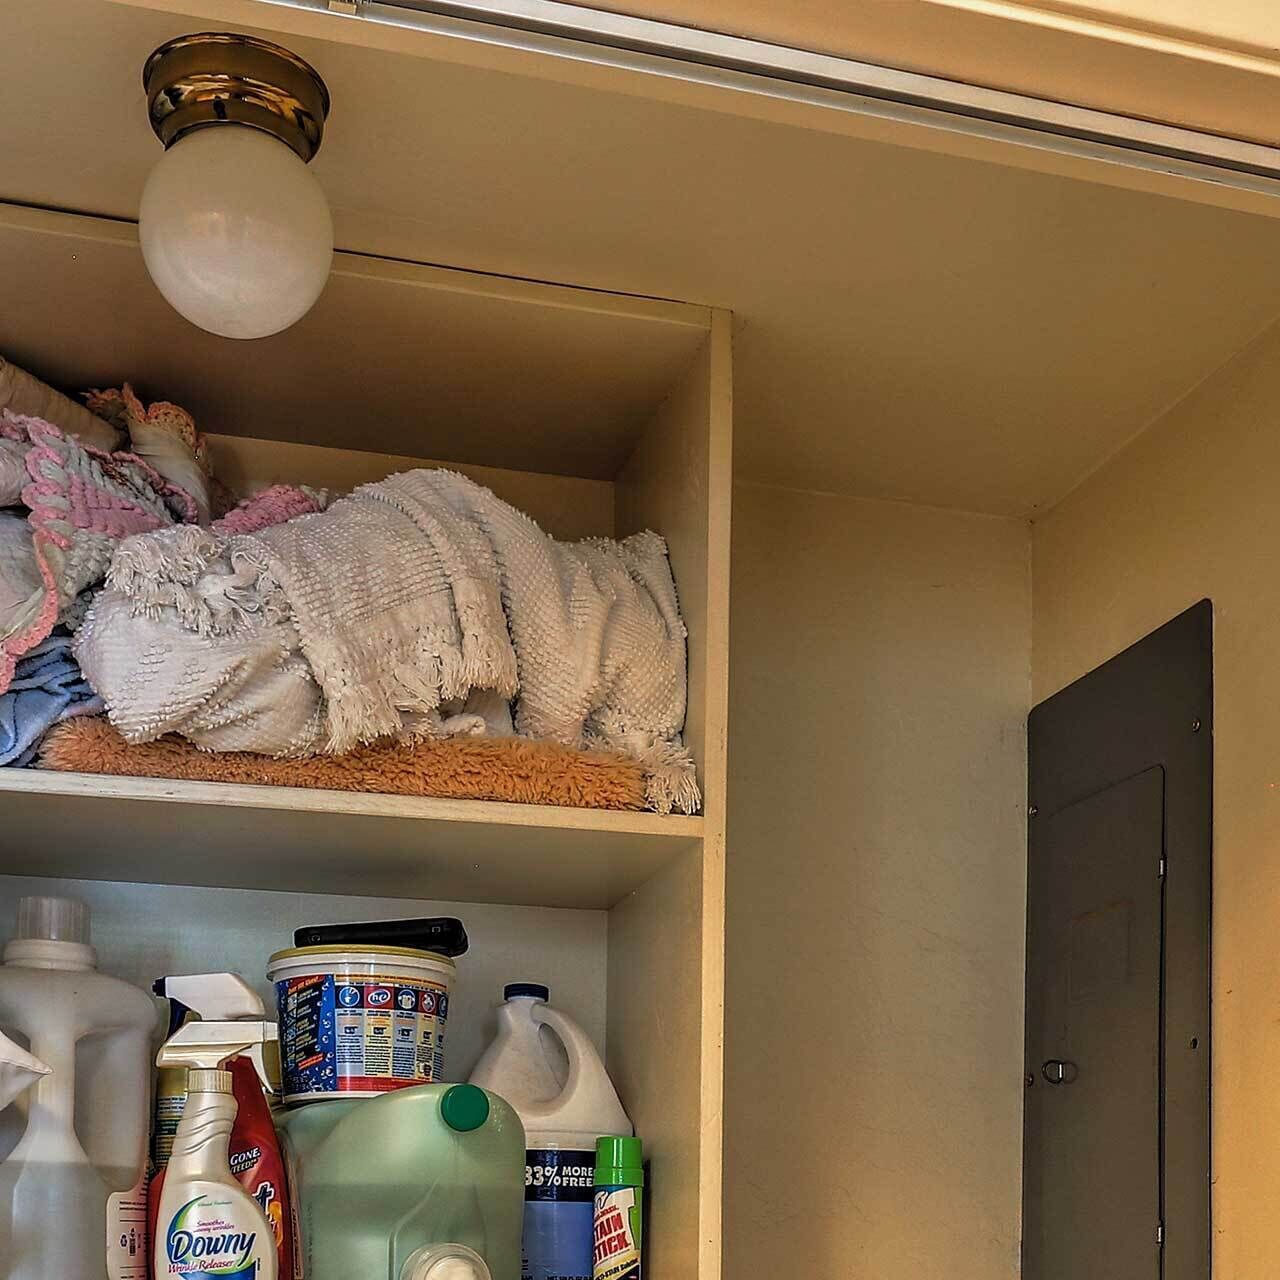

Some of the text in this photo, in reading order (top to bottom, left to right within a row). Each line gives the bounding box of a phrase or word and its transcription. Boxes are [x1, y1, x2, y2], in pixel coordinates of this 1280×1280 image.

[562, 1166, 593, 1177] MORE
[562, 1177, 593, 1187] FREE
[594, 1212, 624, 1241] TAIN
[172, 1230, 257, 1267] Downy
[168, 1262, 198, 1274] Wrinkle
[199, 1259, 234, 1271] Releaser
